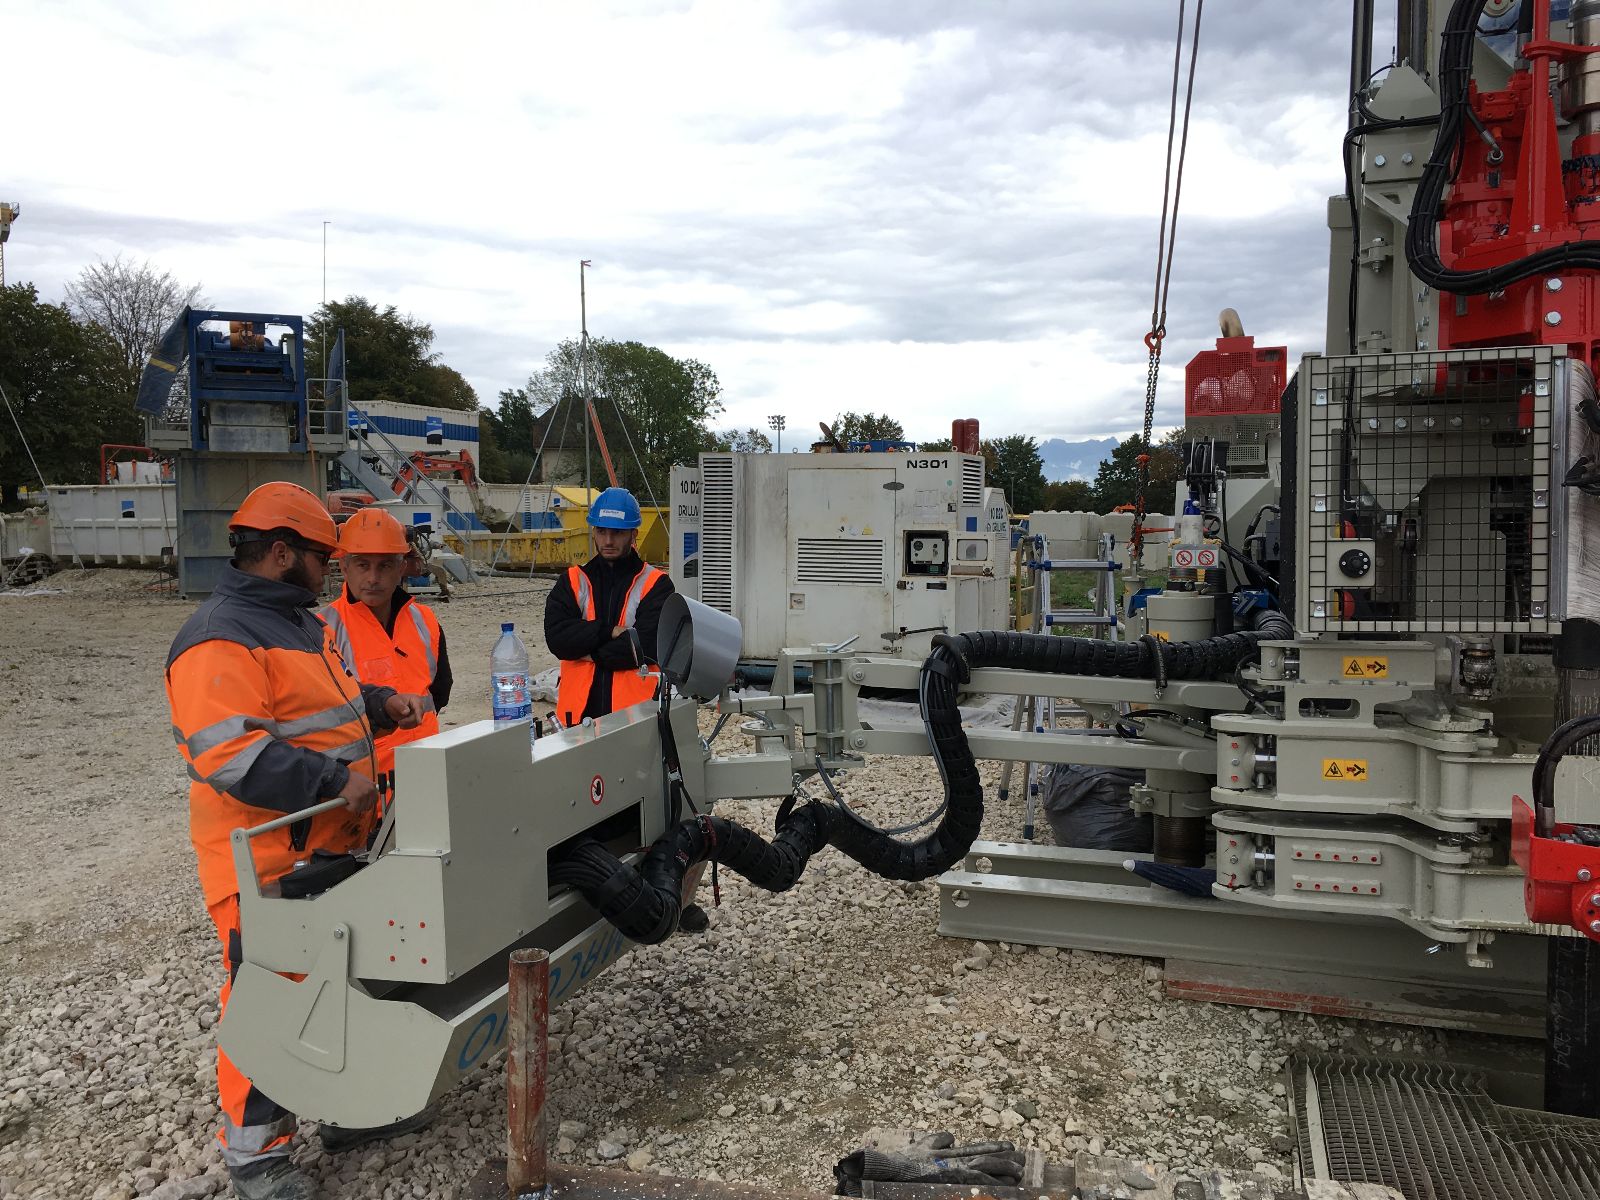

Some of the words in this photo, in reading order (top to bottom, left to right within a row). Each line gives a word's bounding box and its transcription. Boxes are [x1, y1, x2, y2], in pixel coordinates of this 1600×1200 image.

[906, 459, 948, 469] N301
[680, 480, 688, 494] 10
[690, 480, 699, 494] D2
